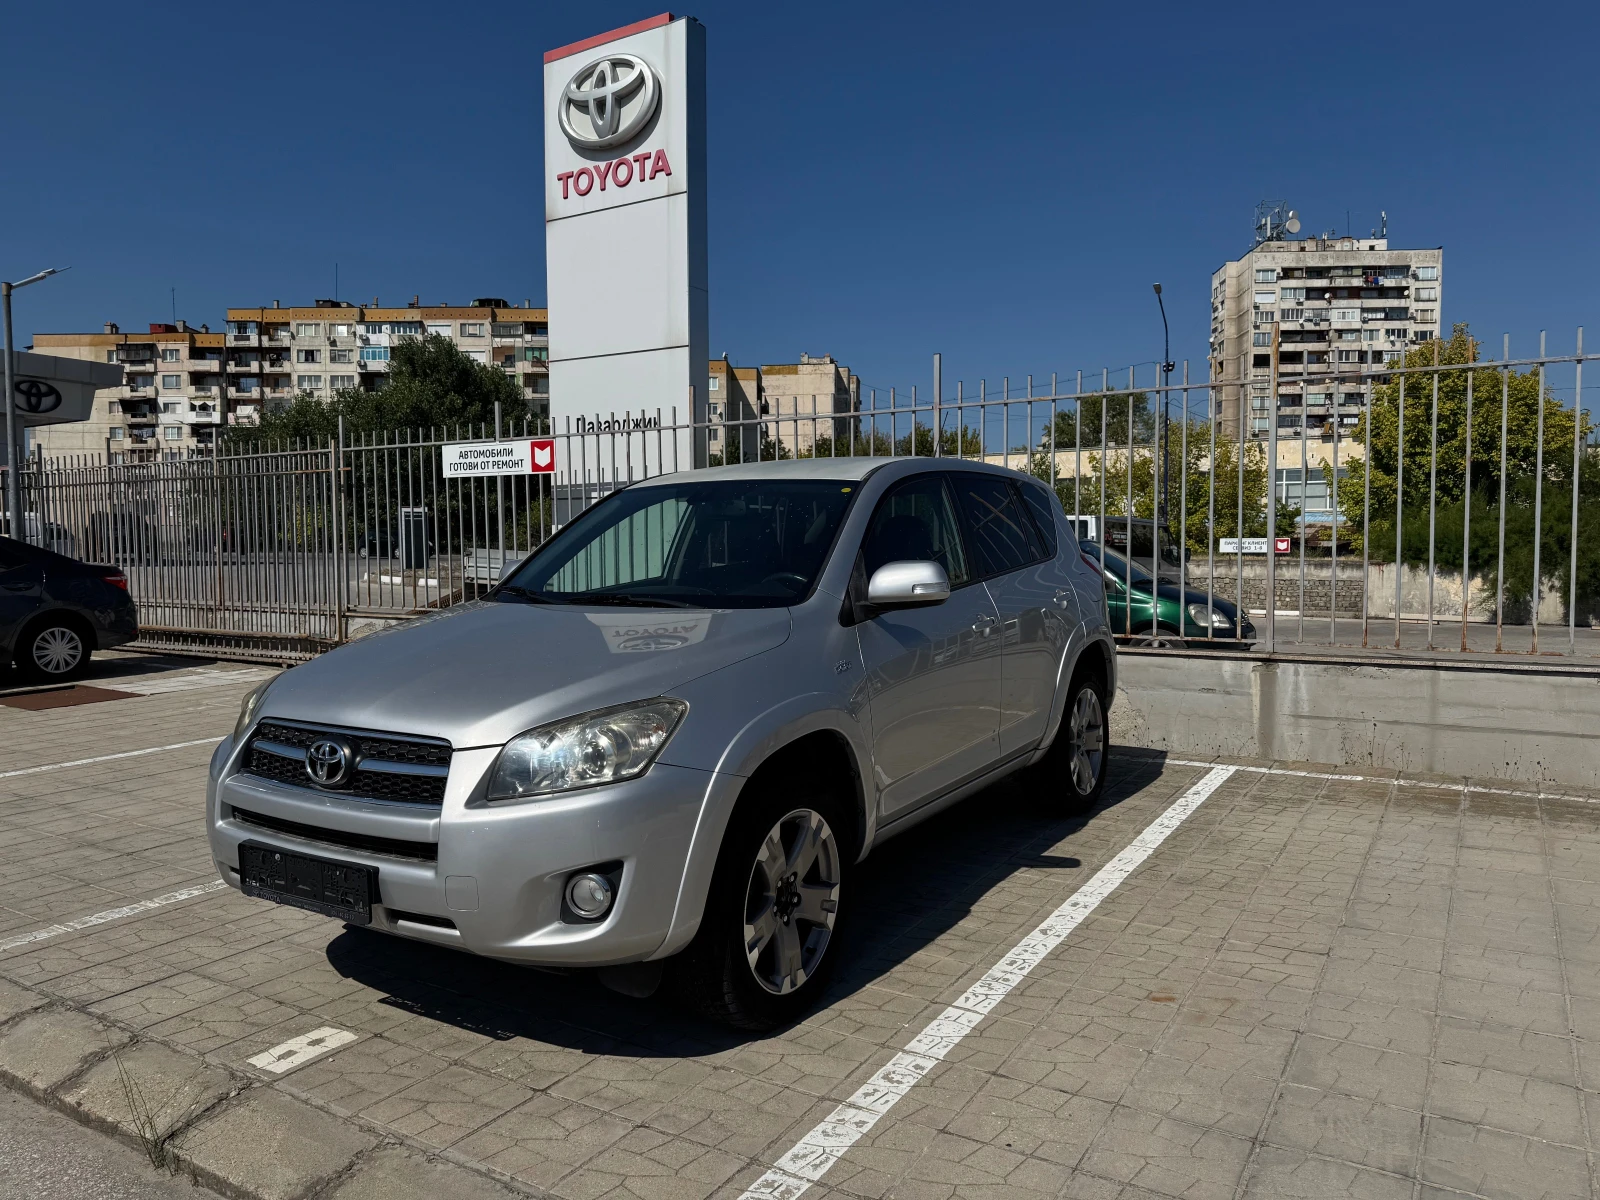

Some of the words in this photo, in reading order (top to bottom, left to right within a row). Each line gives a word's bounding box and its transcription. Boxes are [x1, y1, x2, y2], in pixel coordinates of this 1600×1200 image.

[557, 149, 672, 199] TOYOTA
[459, 448, 514, 460] АВТОМОБИЛИ
[449, 461, 479, 472] ГОТОВИ
[480, 460, 491, 470] ОТ
[492, 458, 524, 470] РЕМОНТ
